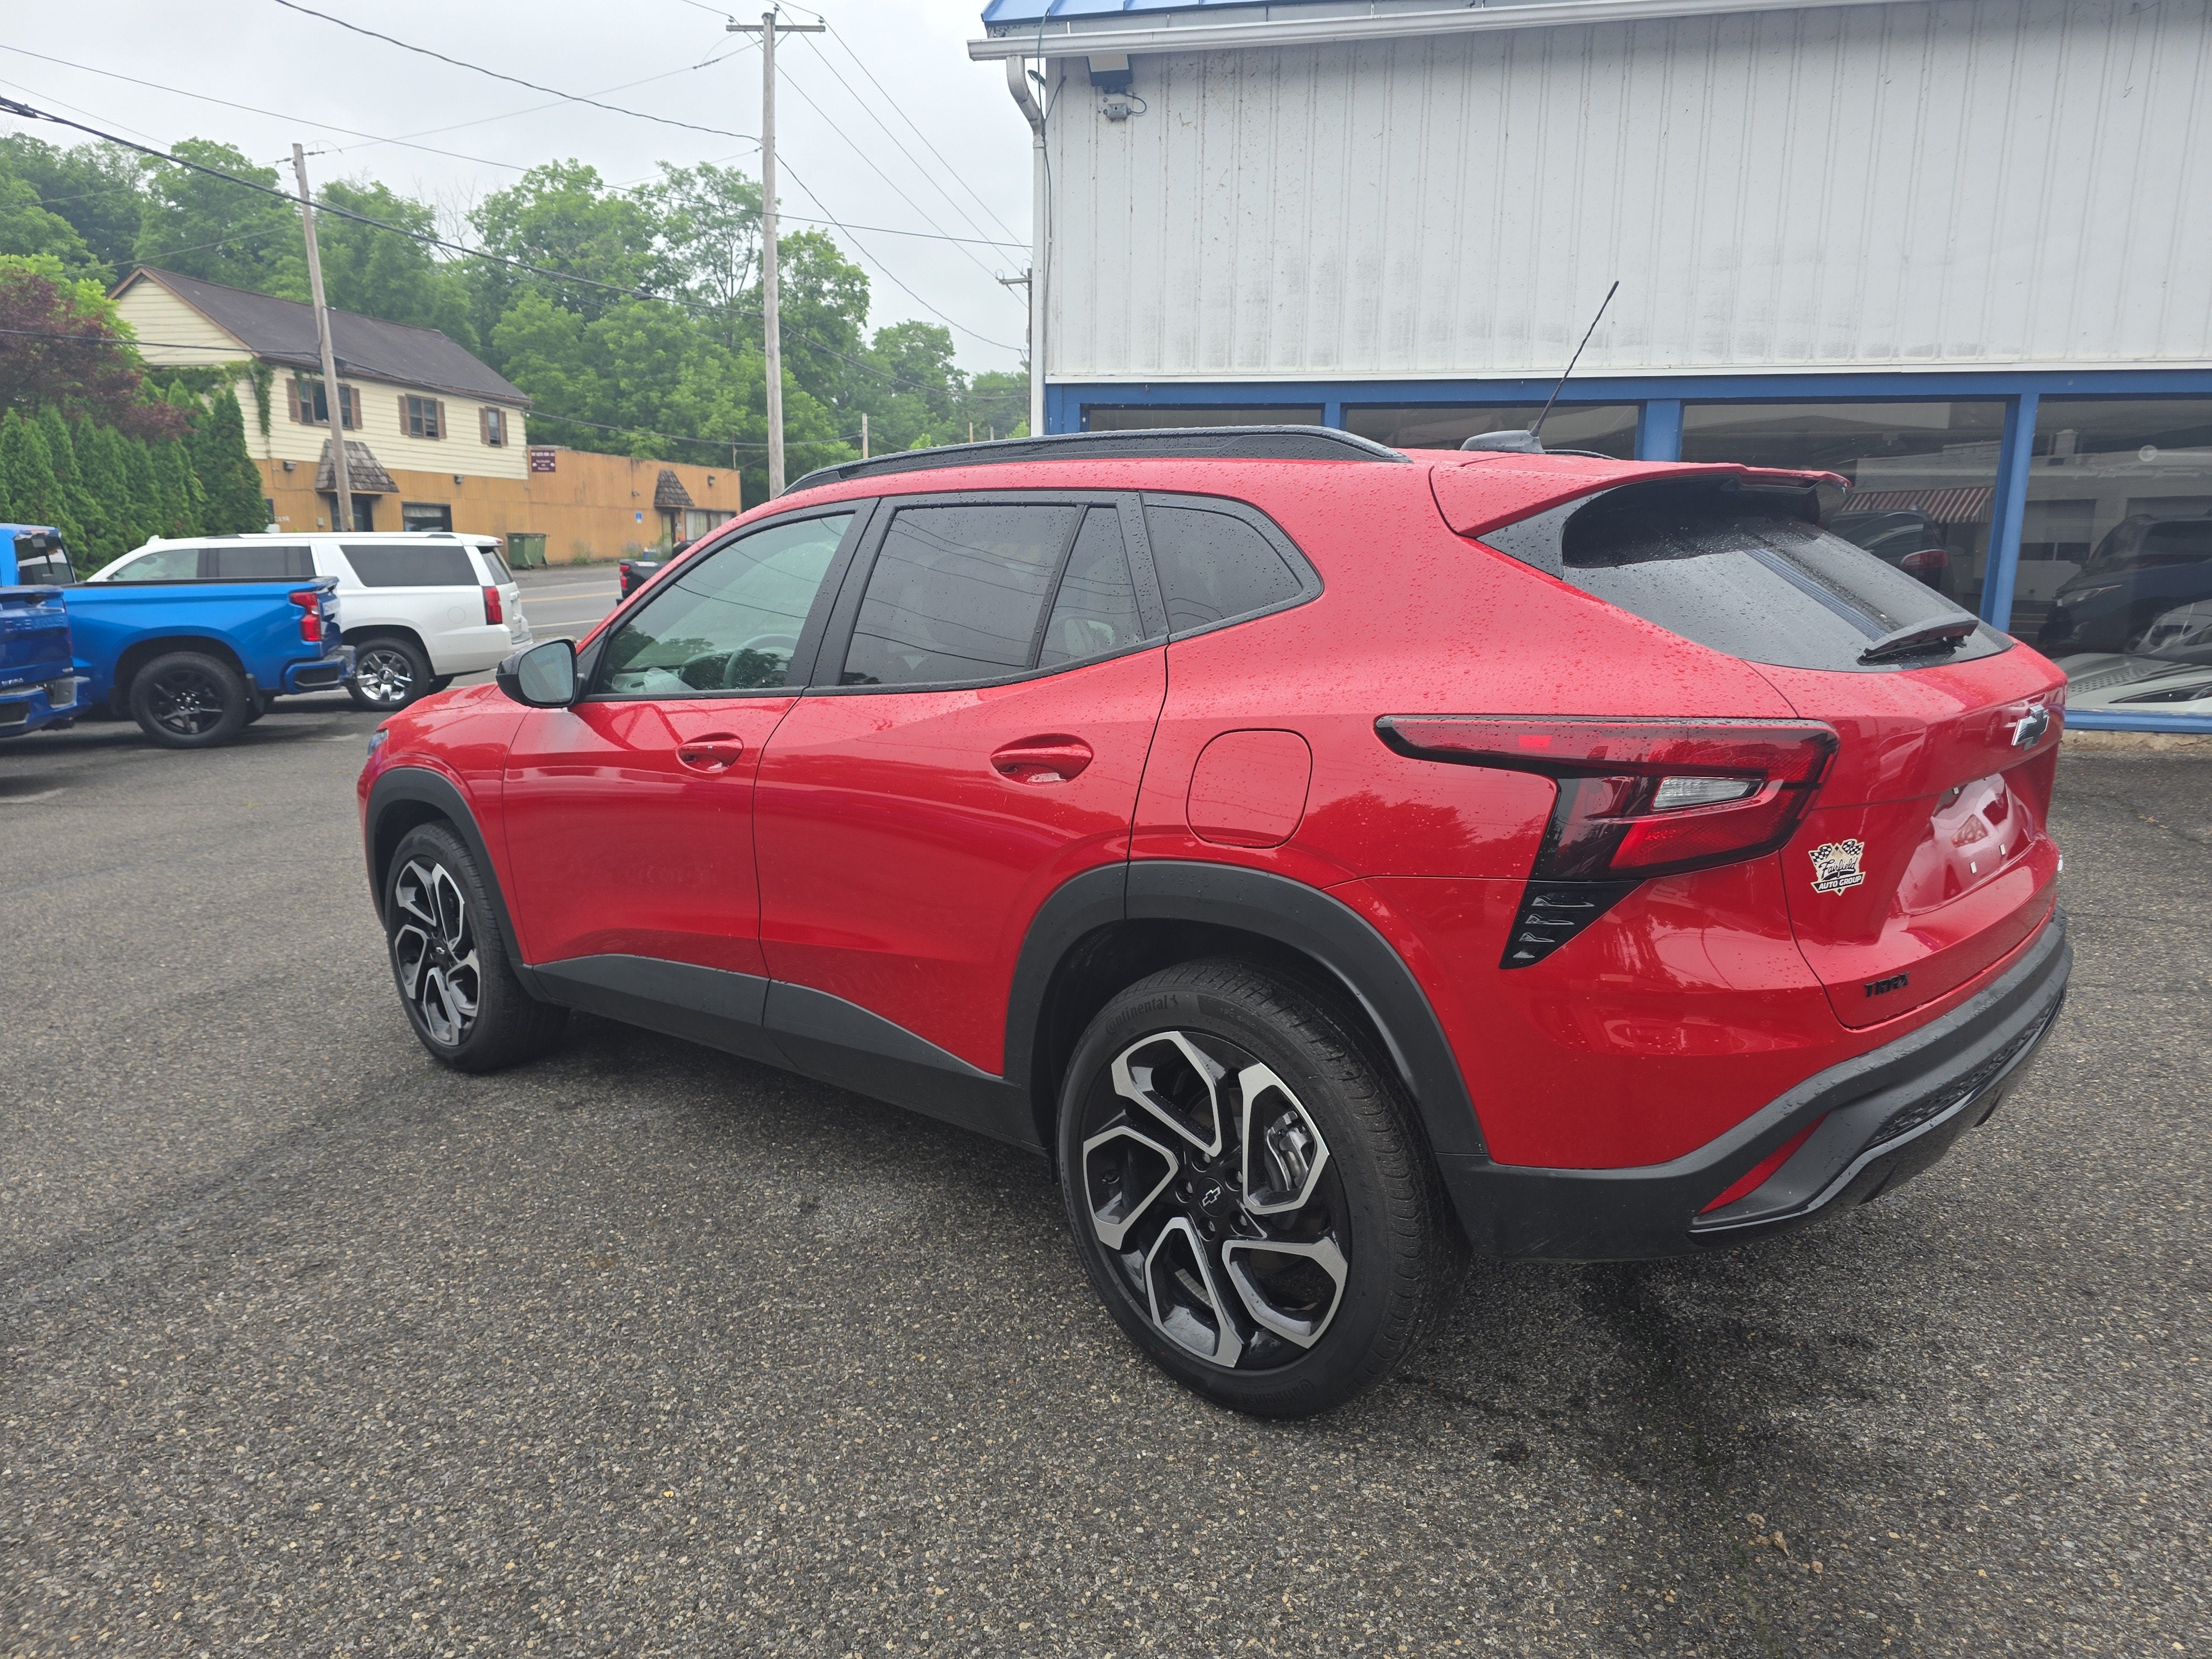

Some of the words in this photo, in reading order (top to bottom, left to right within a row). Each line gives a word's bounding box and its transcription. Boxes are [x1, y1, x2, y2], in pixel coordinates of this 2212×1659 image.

[1818, 857, 1858, 879] Fairfield
[1818, 879, 1838, 890] AUTO
[1839, 875, 1862, 886] GROUP
[1105, 994, 1169, 1034] Continental
